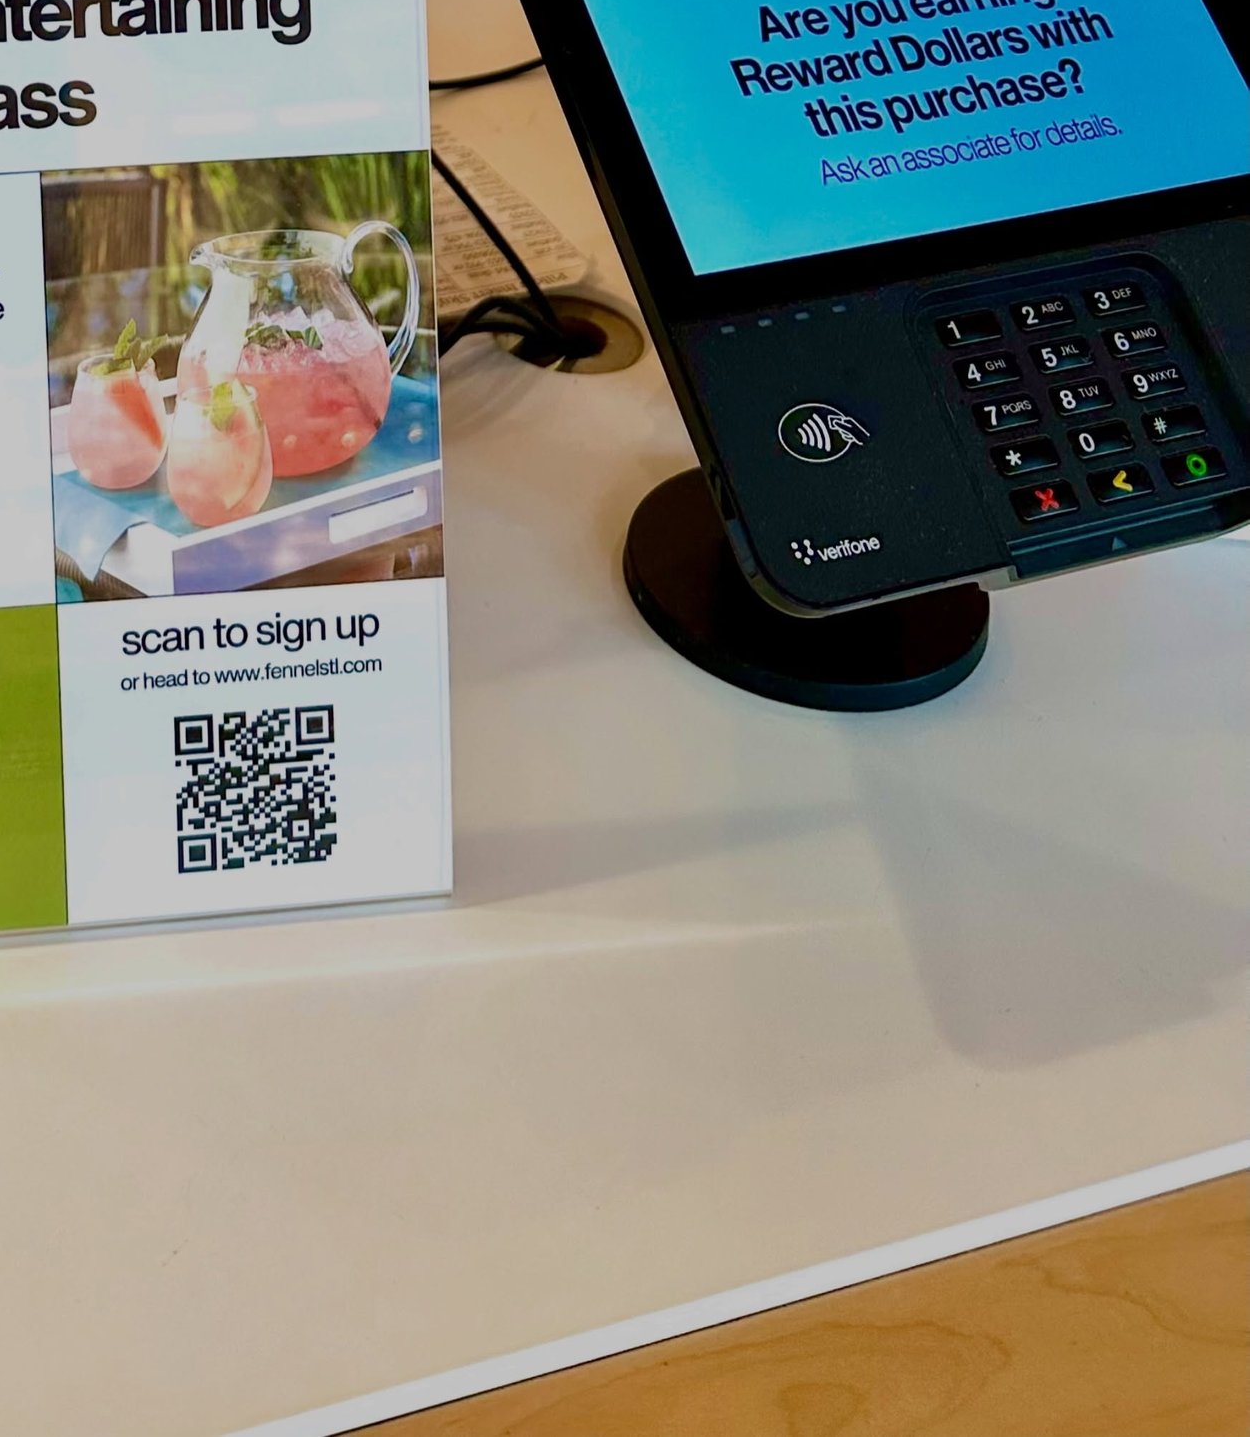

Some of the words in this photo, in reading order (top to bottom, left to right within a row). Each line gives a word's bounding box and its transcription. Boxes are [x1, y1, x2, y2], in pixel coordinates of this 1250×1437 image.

[760, 6, 830, 43] Are
[731, 40, 889, 97] Reward
[890, 27, 1030, 72] Dollars
[1028, 7, 1114, 50] with
[805, 99, 883, 137] this
[886, 59, 1084, 134] purchase?
[822, 157, 871, 186] Ask
[870, 157, 901, 178] an
[903, 135, 1013, 172] associate
[1011, 128, 1042, 152] for
[1046, 114, 1123, 147] details.
[1094, 291, 1110, 310] 3
[1111, 287, 1132, 300] DEF
[1021, 305, 1039, 325] 2
[1041, 301, 1064, 314] ABC
[947, 320, 961, 339] 1
[1113, 332, 1130, 351] 6
[1131, 327, 1157, 340] MNO
[1041, 347, 1058, 367] 5
[1061, 344, 1079, 356] JKL
[967, 363, 982, 382] 4
[985, 359, 1006, 371] GHI
[1132, 374, 1149, 393] 9
[1147, 368, 1179, 383] WXYZ
[1059, 390, 1077, 410] 8
[1078, 385, 1099, 398] TUV
[984, 406, 998, 426] 7
[1001, 400, 1032, 414] PQRS
[1078, 432, 1096, 453] 0
[817, 536, 881, 561] verifone
[122, 626, 205, 656] scan
[212, 620, 249, 649] to
[256, 617, 327, 653] sign
[336, 613, 380, 647] up
[120, 676, 140, 691] or
[143, 669, 189, 690] head
[192, 669, 211, 685] to
[214, 657, 382, 684] www.fennelstl.com
